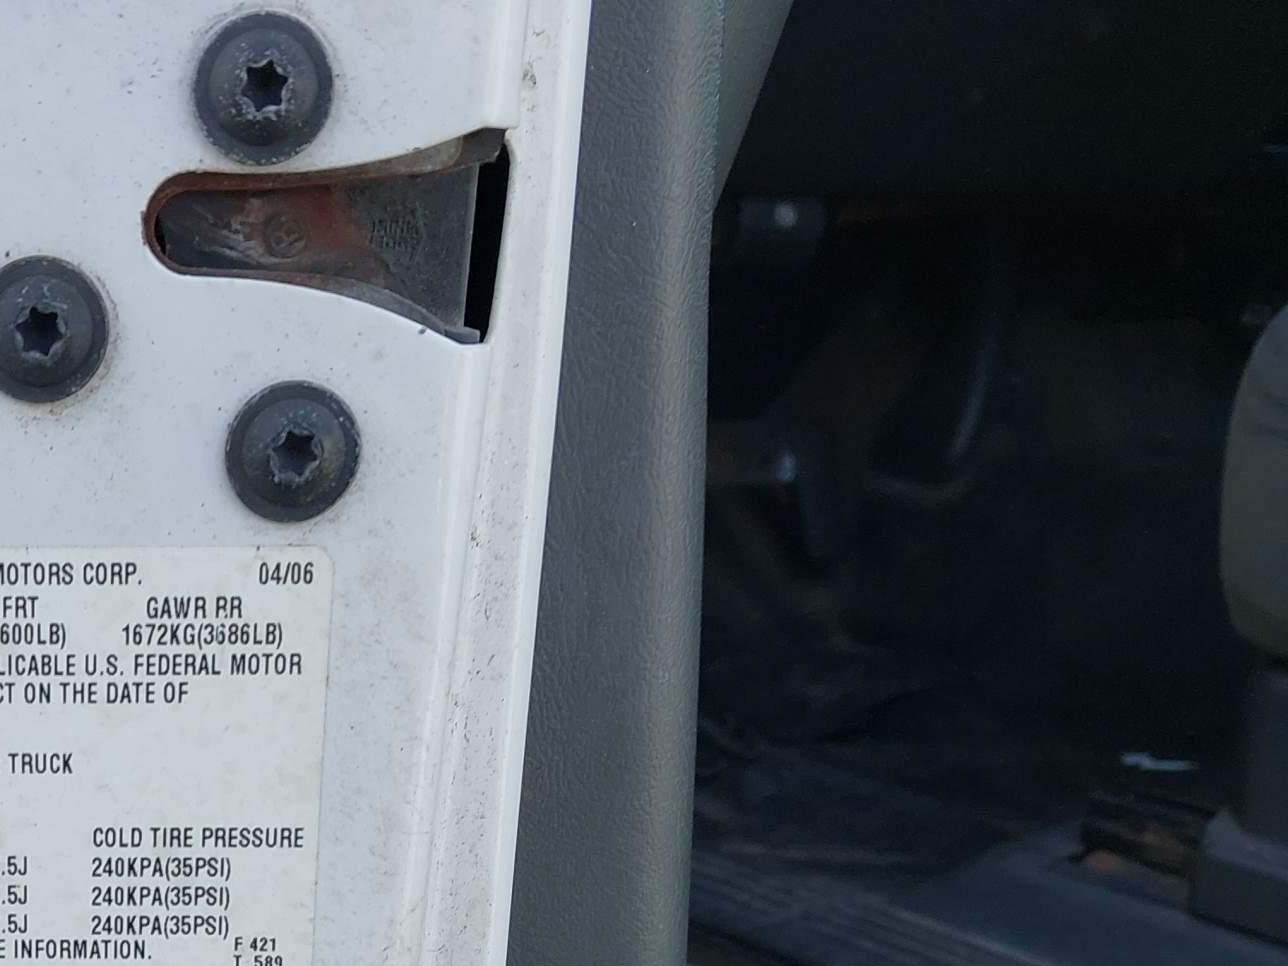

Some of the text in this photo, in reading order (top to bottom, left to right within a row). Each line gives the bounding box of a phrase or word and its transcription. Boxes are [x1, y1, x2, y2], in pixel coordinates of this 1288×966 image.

[84, 563, 141, 585] CORP.
[259, 562, 313, 584] 04/06
[3, 596, 38, 618] FRT
[147, 596, 242, 619] GAWR RR
[123, 623, 282, 650] 1672KG(3686LB)
[86, 654, 123, 675] U.S.
[135, 654, 220, 675] FEDERAL
[231, 653, 301, 675] MOTOR
[25, 683, 50, 703] ON
[60, 683, 97, 703] THE
[107, 682, 155, 703] DATE
[164, 682, 188, 703] OF
[8, 753, 72, 773] TRUCK
[93, 828, 303, 848] COLD TIRE PRESSURE
[92, 857, 230, 881] 240KPA(35PSI)
[92, 886, 229, 910] 240KPA(35PSI)
[92, 916, 228, 939] 240KPA(35PSI)
[15, 940, 151, 959] INFORMATION.
[235, 937, 275, 951] F 421
